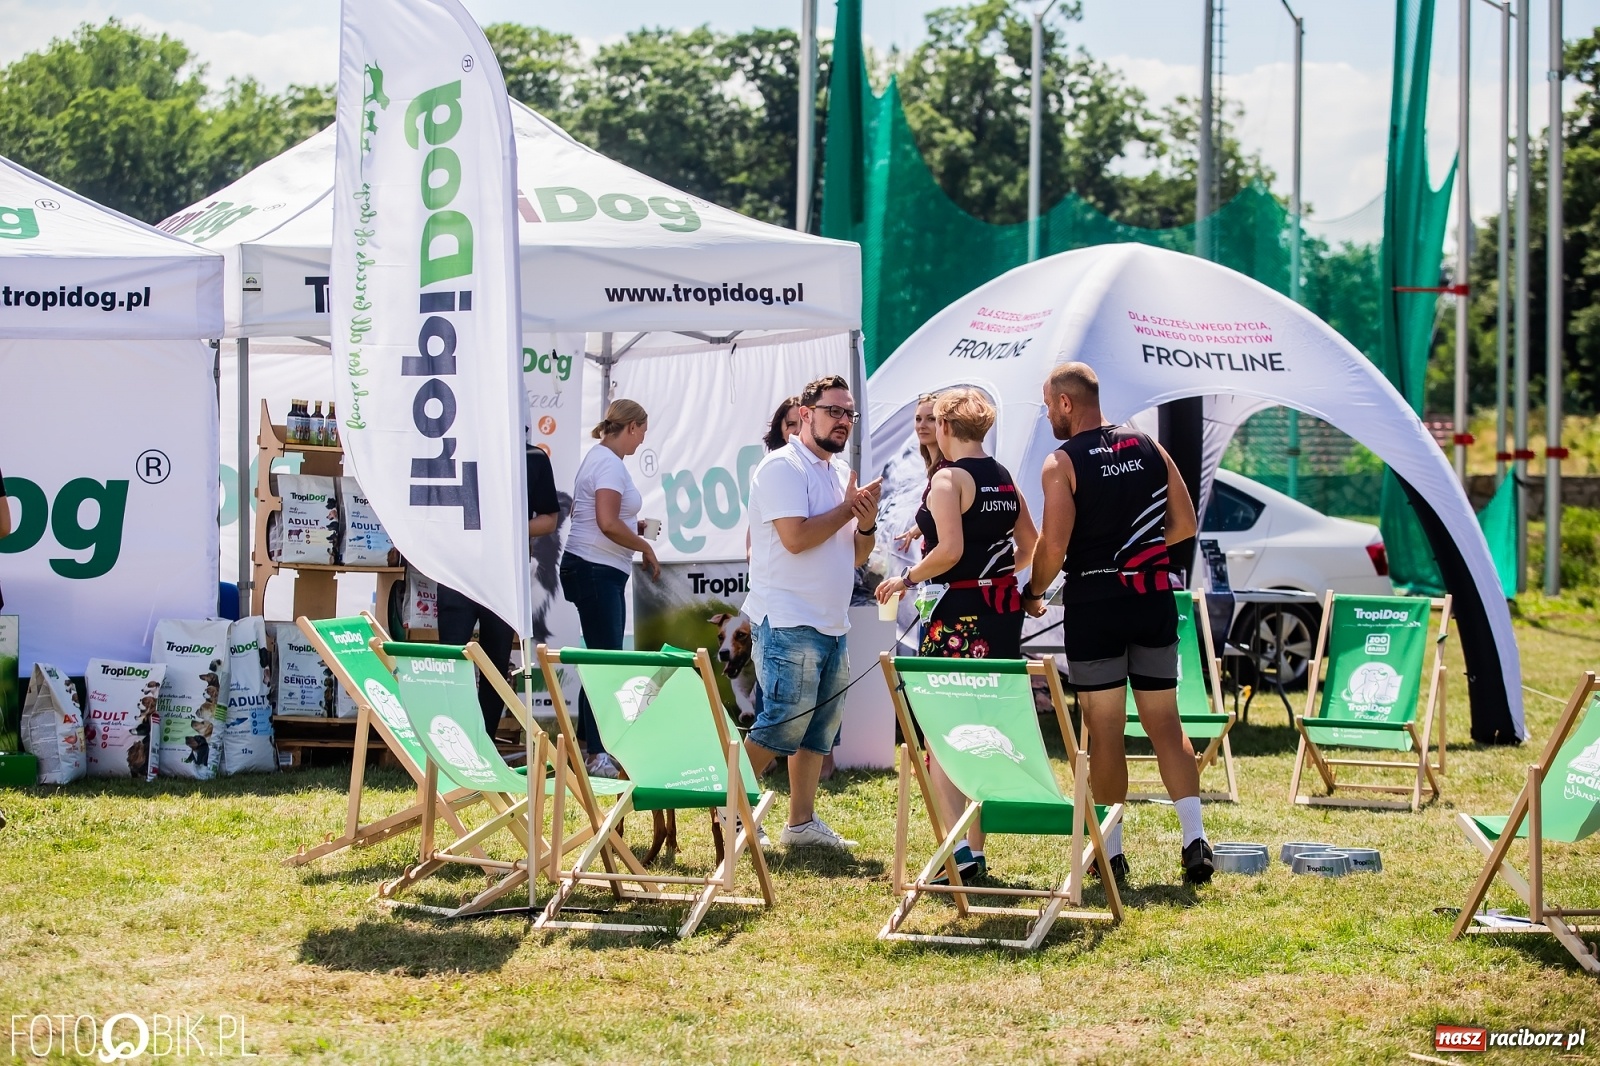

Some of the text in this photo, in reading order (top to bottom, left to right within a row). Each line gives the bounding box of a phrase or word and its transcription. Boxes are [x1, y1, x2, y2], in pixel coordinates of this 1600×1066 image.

[2, 286, 151, 311] tropidog.pl
[604, 283, 804, 306] www.tropidog.pl
[1128, 310, 1149, 323] DLA
[1133, 324, 1187, 341] WOLNEGO
[1189, 334, 1204, 343] OD
[949, 338, 1033, 360] FRONTLINE
[1142, 344, 1285, 372] FRONTLINE
[527, 390, 564, 409] zed
[290, 492, 326, 502] TropiDog
[981, 500, 1016, 512] JUSTYNA
[288, 517, 320, 526] ADULT
[351, 521, 381, 531] ADULT
[688, 573, 751, 597] Tropi
[1354, 607, 1409, 622] TropiDog
[166, 641, 214, 654] TropiDog
[288, 643, 319, 654] TropiDo
[101, 665, 149, 678] TropiDog
[284, 676, 317, 686] SENIOR
[228, 695, 266, 708] ADULT
[1348, 703, 1392, 714] TropiDog
[1307, 865, 1334, 873] TropiDog
